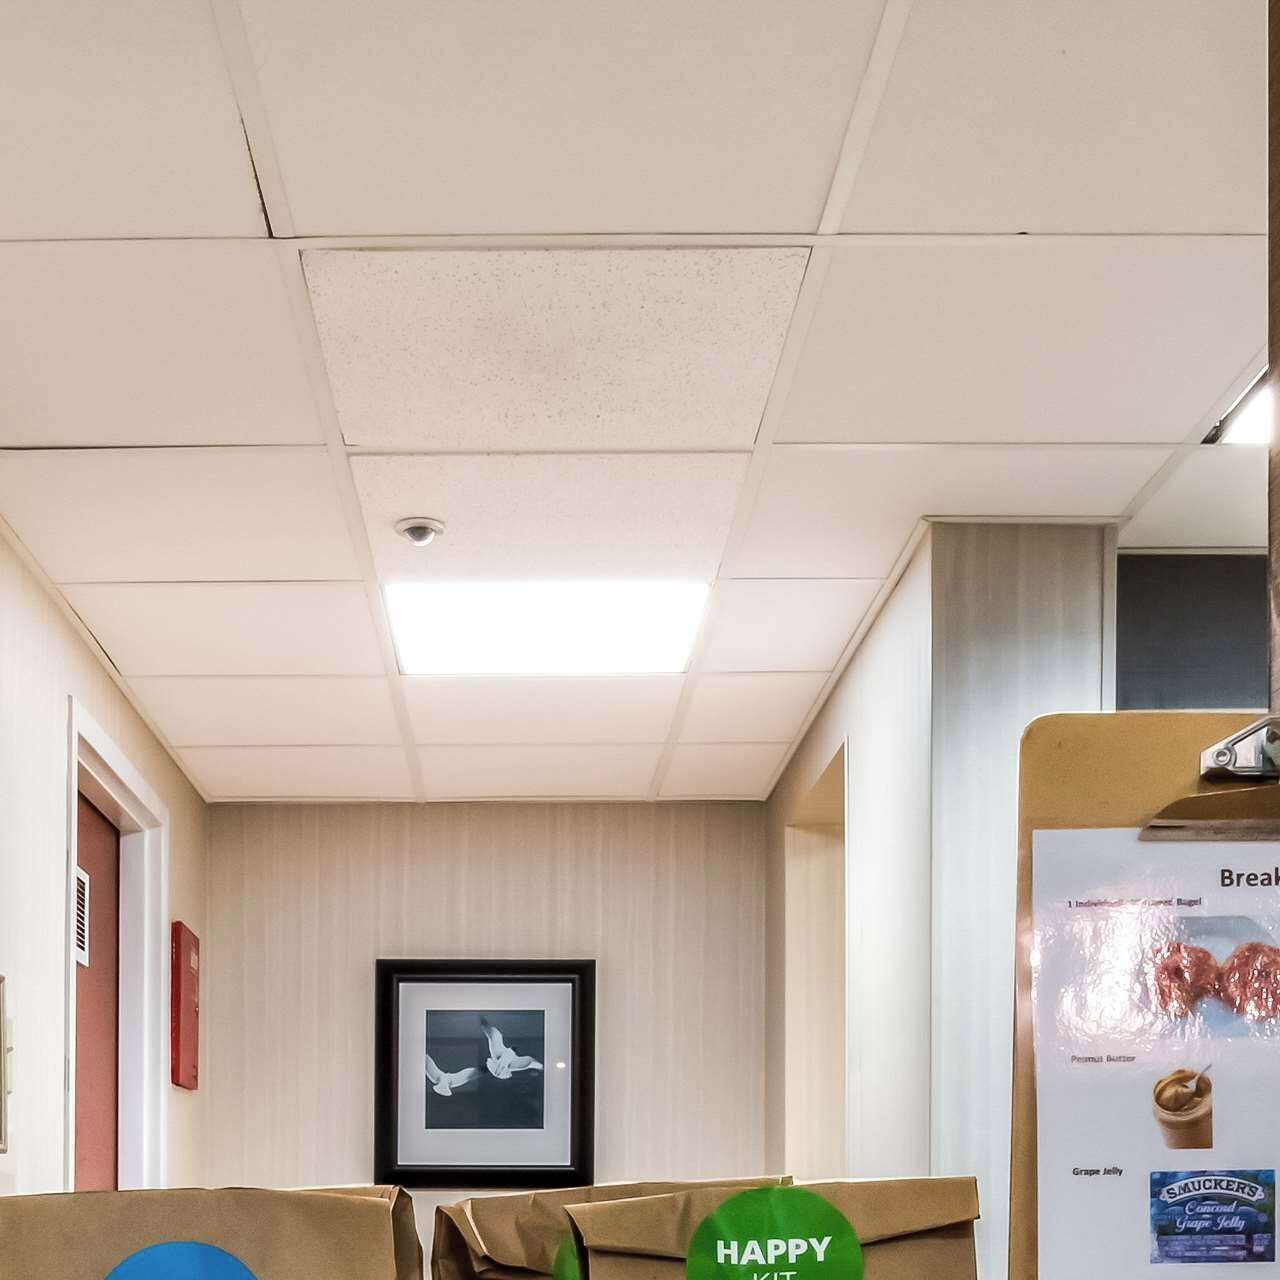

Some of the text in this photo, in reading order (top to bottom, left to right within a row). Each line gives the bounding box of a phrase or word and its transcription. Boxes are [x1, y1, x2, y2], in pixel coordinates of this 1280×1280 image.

[1176, 897, 1202, 907] Bagel
[1072, 1166, 1123, 1177] Grape Jelly
[1185, 1200, 1238, 1215] Concord
[1175, 1216, 1246, 1233] Grape Jelly
[716, 1236, 832, 1265] HAPPY
